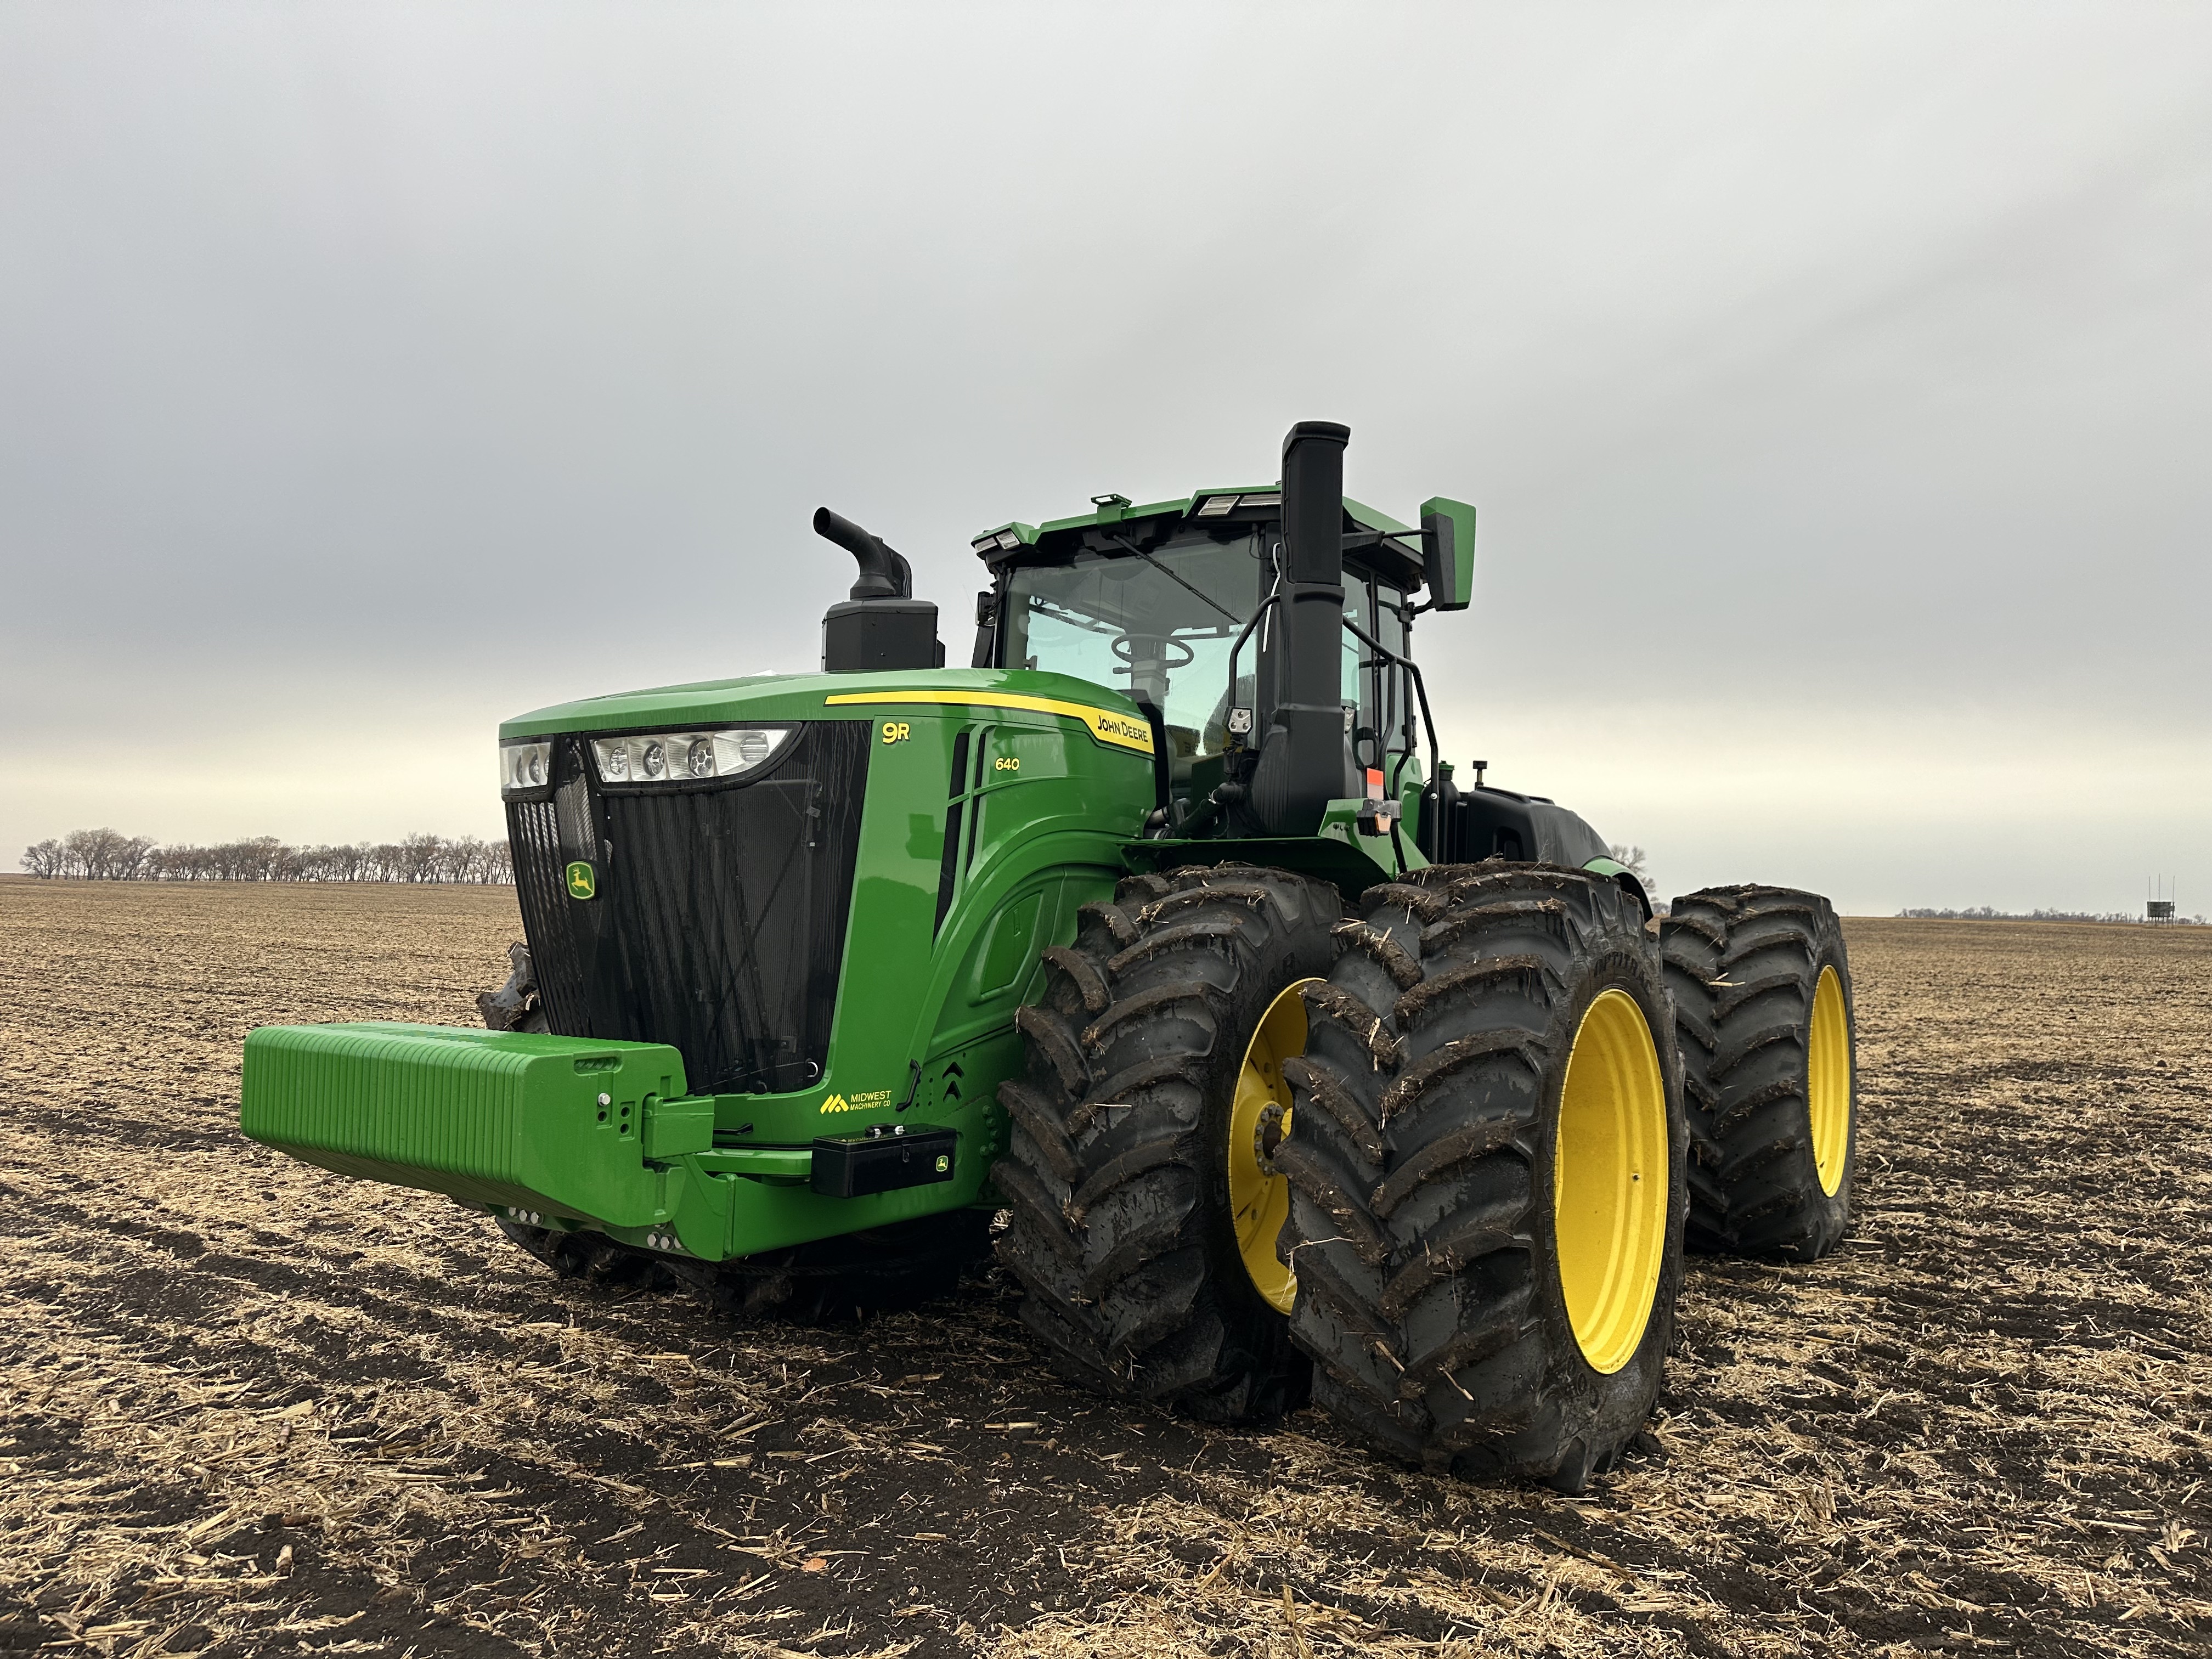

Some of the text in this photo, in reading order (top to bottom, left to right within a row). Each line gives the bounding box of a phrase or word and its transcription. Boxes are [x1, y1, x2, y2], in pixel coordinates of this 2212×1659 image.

[882, 722, 910, 744] 9R
[1098, 715, 1148, 743] JOHN DEERE
[995, 758, 1020, 770] 640
[850, 1090, 892, 1103] MIDWEST
[850, 1101, 882, 1110] MACHINERY
